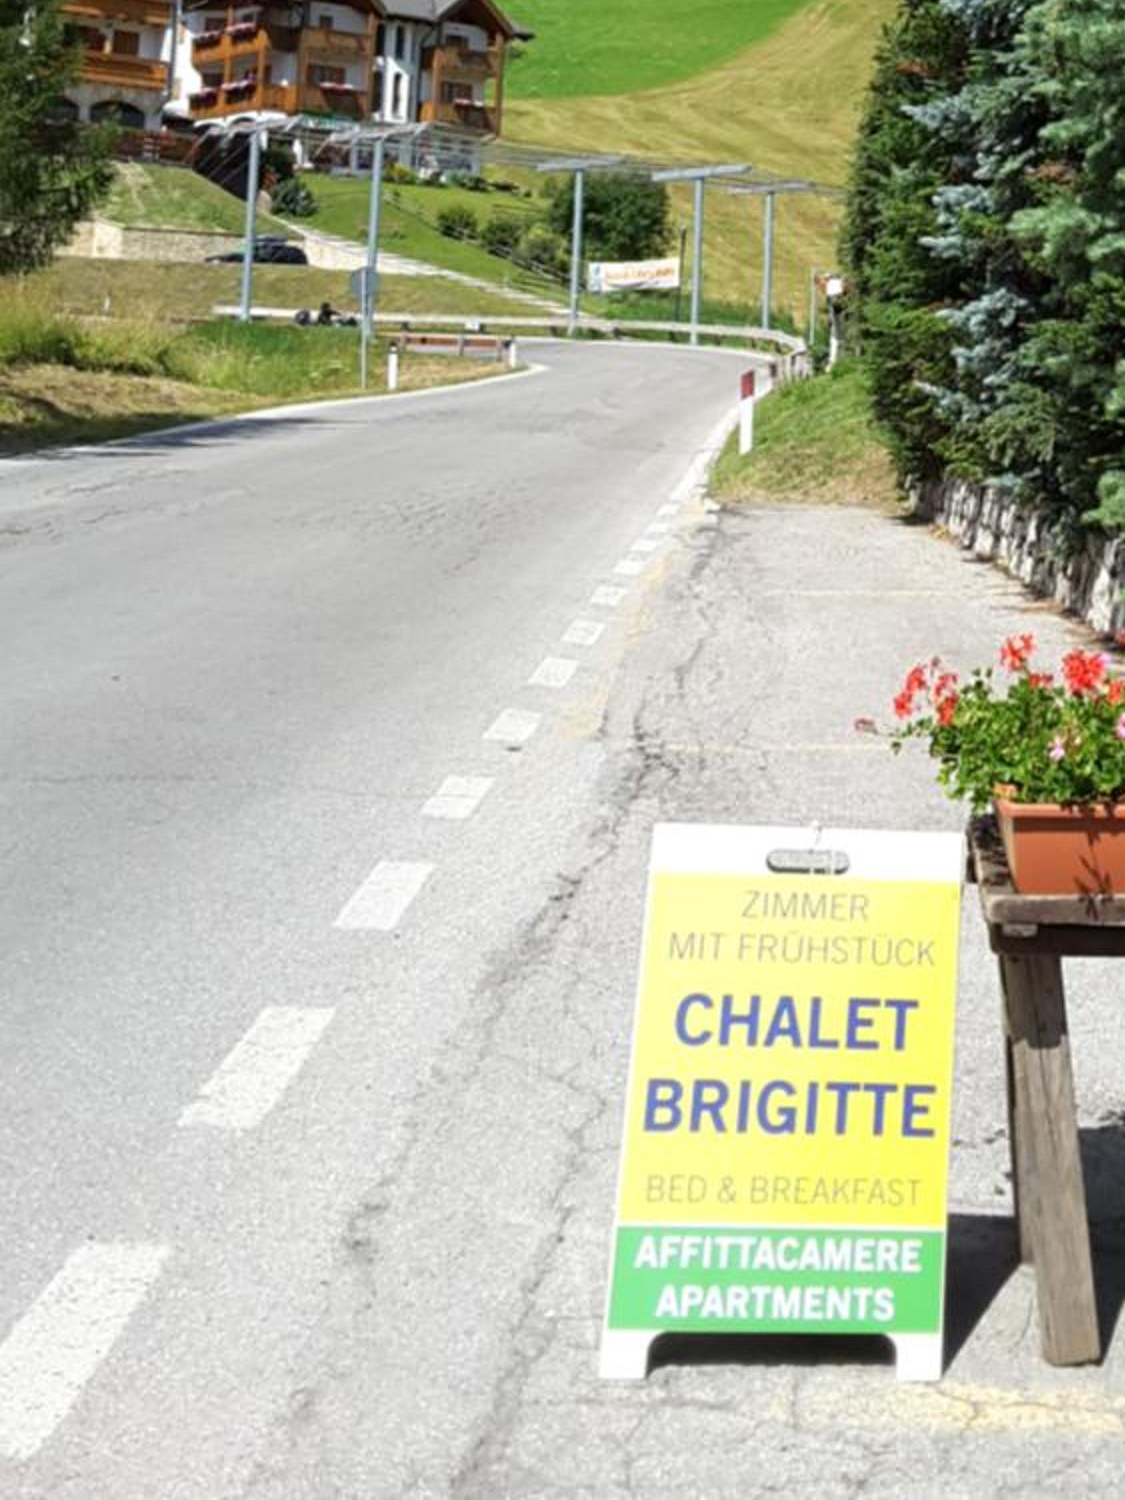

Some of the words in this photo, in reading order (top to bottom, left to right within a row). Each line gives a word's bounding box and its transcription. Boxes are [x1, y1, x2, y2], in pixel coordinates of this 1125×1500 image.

[741, 890, 869, 921] ZIMMER
[668, 932, 724, 962] MIT
[738, 931, 935, 966] FRÜHSTÜCK
[674, 993, 919, 1051] CHALET
[643, 1078, 936, 1138] BRIGITTE
[646, 1174, 708, 1204] BED
[716, 1175, 737, 1204] &
[749, 1175, 923, 1208] BREAKFAST
[634, 1235, 922, 1272] AFFITTACAMERE
[655, 1285, 895, 1321] APARTMENTS
